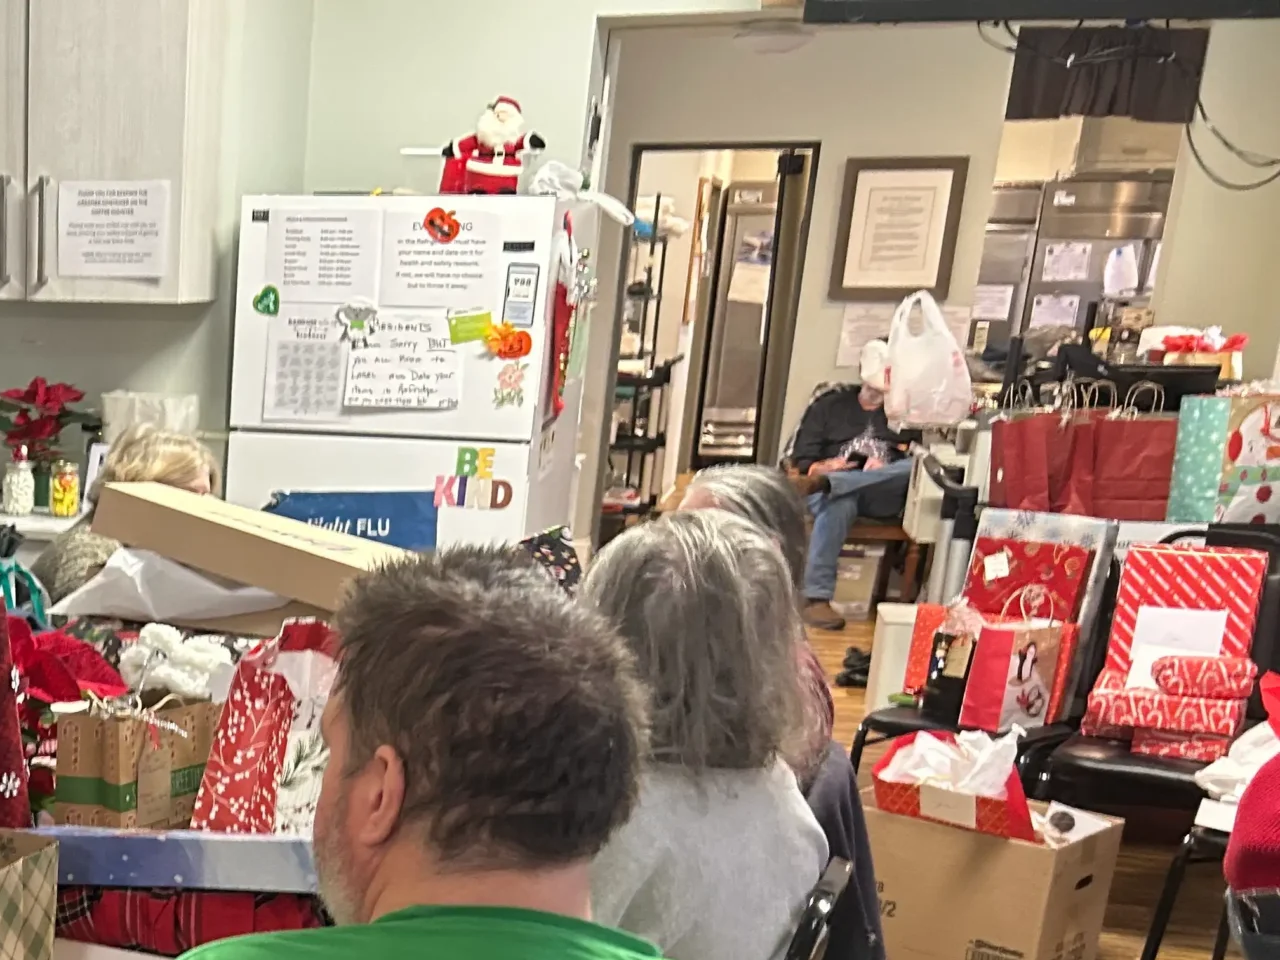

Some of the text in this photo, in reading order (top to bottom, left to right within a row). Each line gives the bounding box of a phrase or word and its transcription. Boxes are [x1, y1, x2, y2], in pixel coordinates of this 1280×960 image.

[456, 446, 496, 479] BE
[433, 475, 513, 510] KIND
[356, 518, 391, 537] FLU
